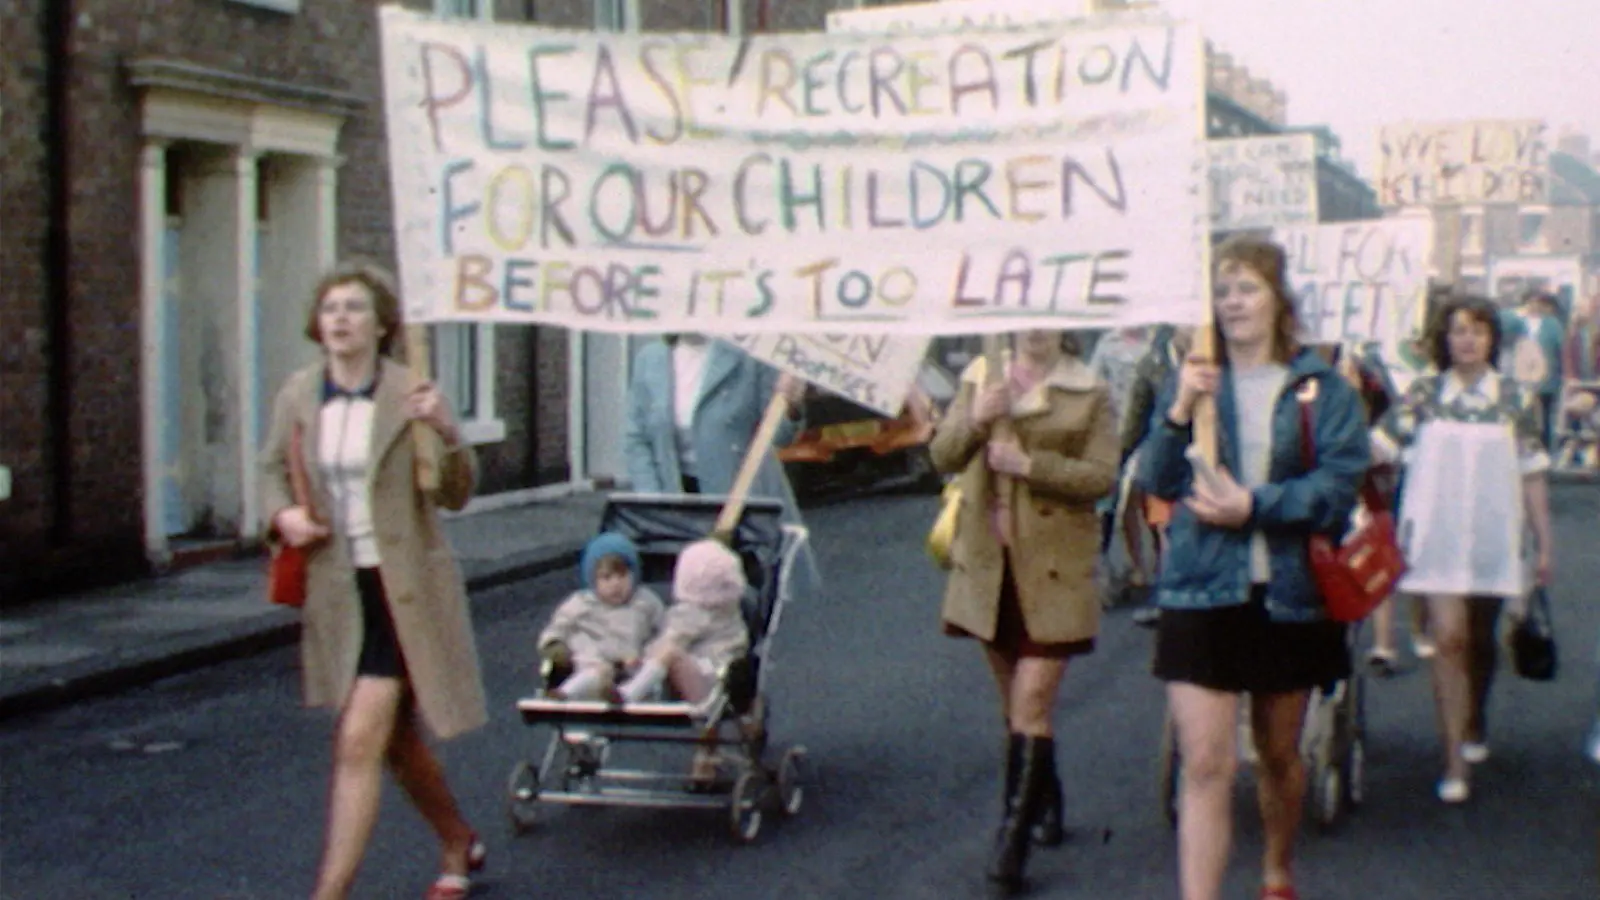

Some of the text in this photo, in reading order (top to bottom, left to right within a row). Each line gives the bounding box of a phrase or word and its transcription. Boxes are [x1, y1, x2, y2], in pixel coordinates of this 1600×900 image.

[757, 25, 1175, 119] RECREATION
[1469, 121, 1548, 165] LOVE
[441, 148, 1128, 256] FOR OUR CHILDREN
[451, 246, 1132, 319] BEFORE IT'S TOO LATE
[1337, 226, 1413, 281] FOR
